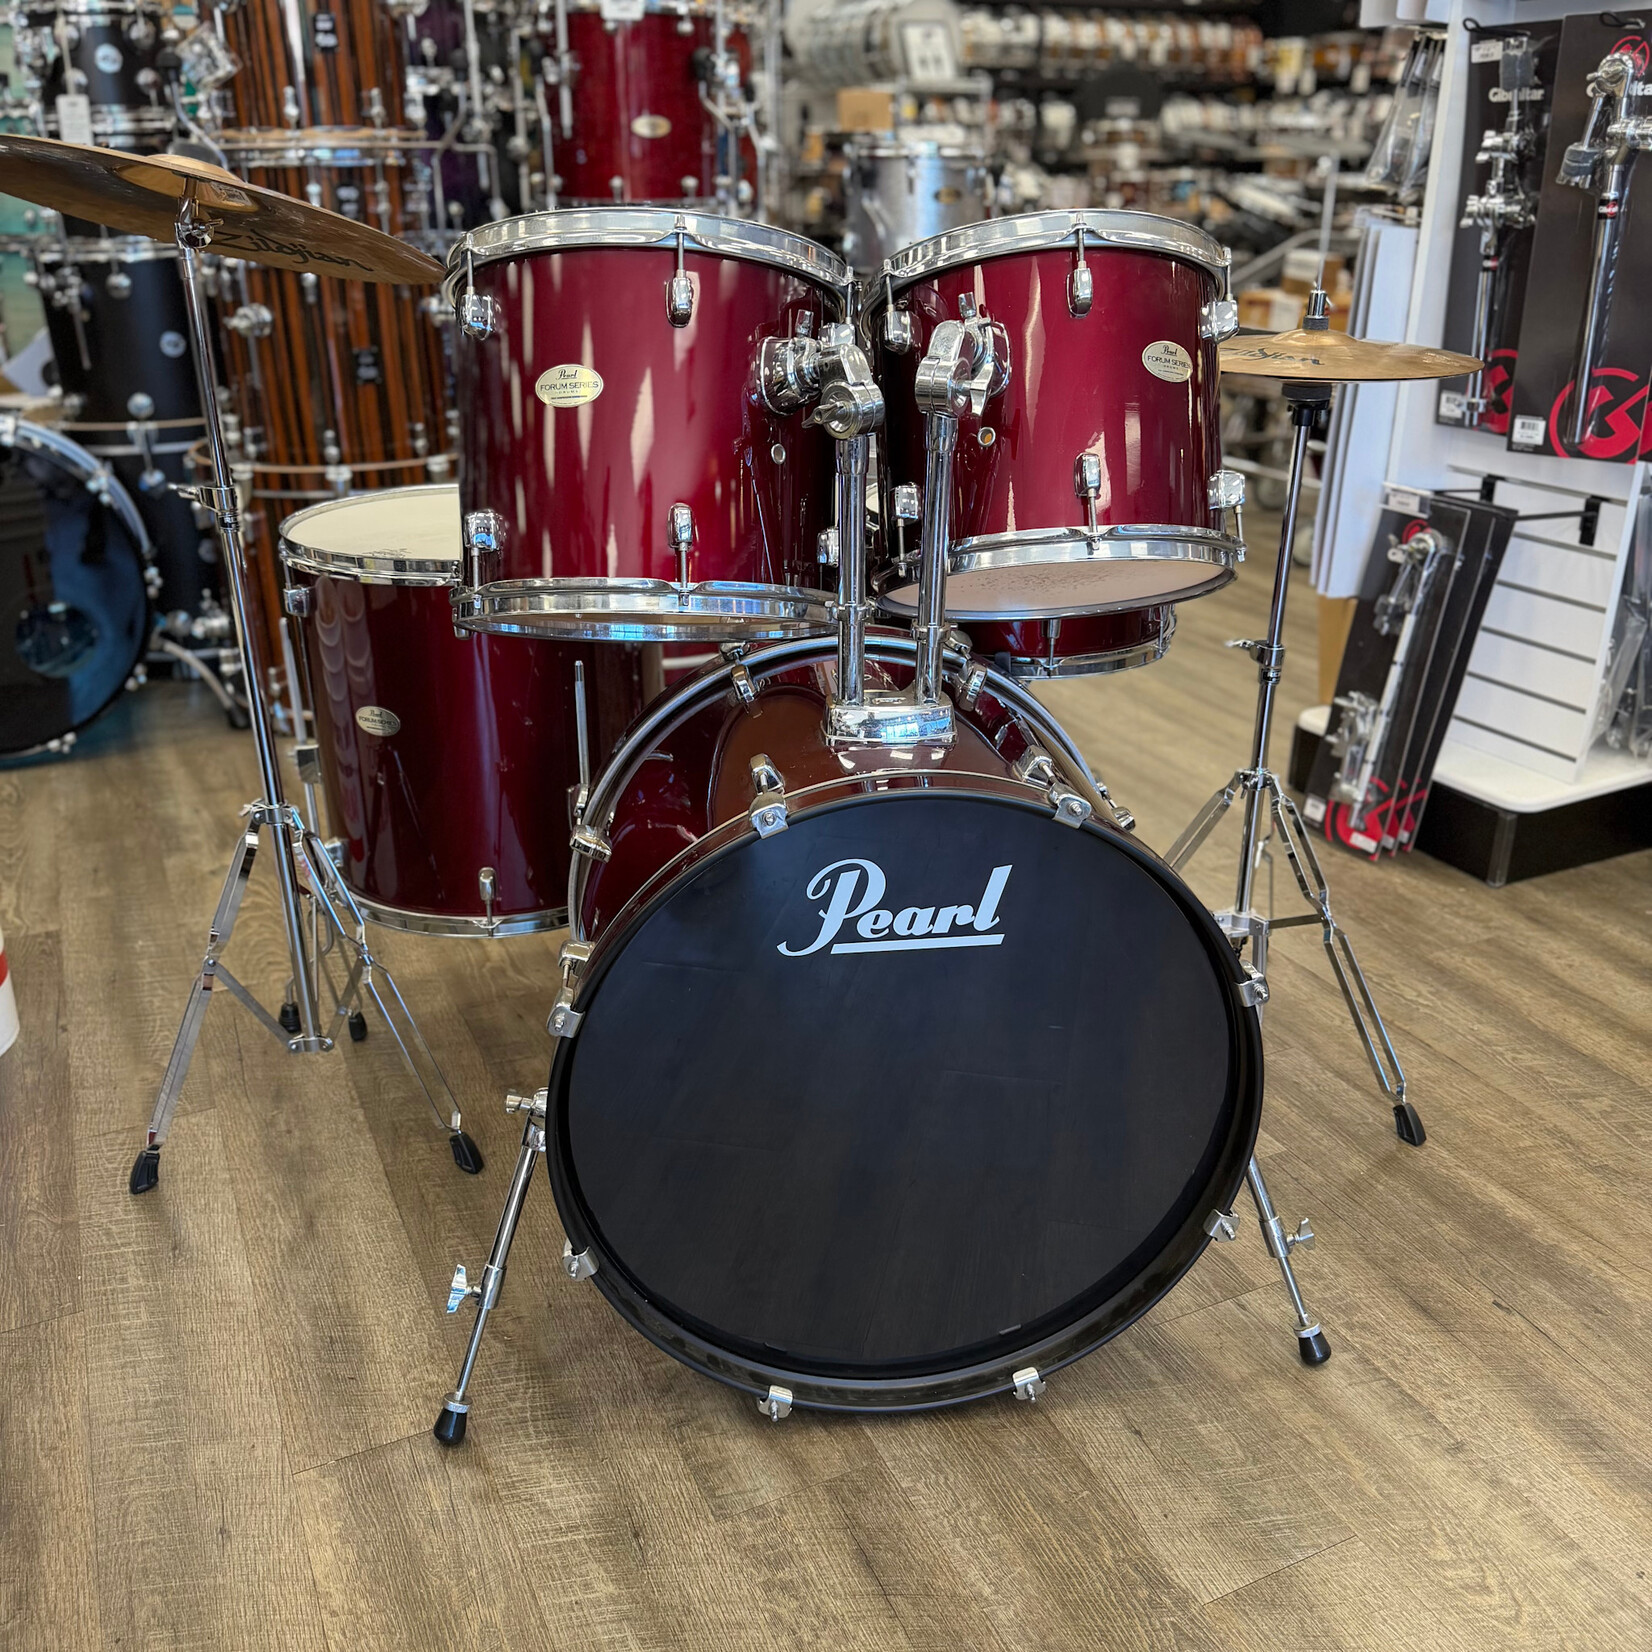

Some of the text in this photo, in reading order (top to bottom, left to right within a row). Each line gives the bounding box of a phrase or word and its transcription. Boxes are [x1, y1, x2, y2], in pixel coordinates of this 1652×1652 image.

[212, 229, 375, 272] Zildjian
[1147, 355, 1191, 369] FORUM SERIES
[556, 369, 578, 381] Pearl
[540, 380, 599, 392] FORUM SERIES
[776, 858, 1013, 957] Pearl
